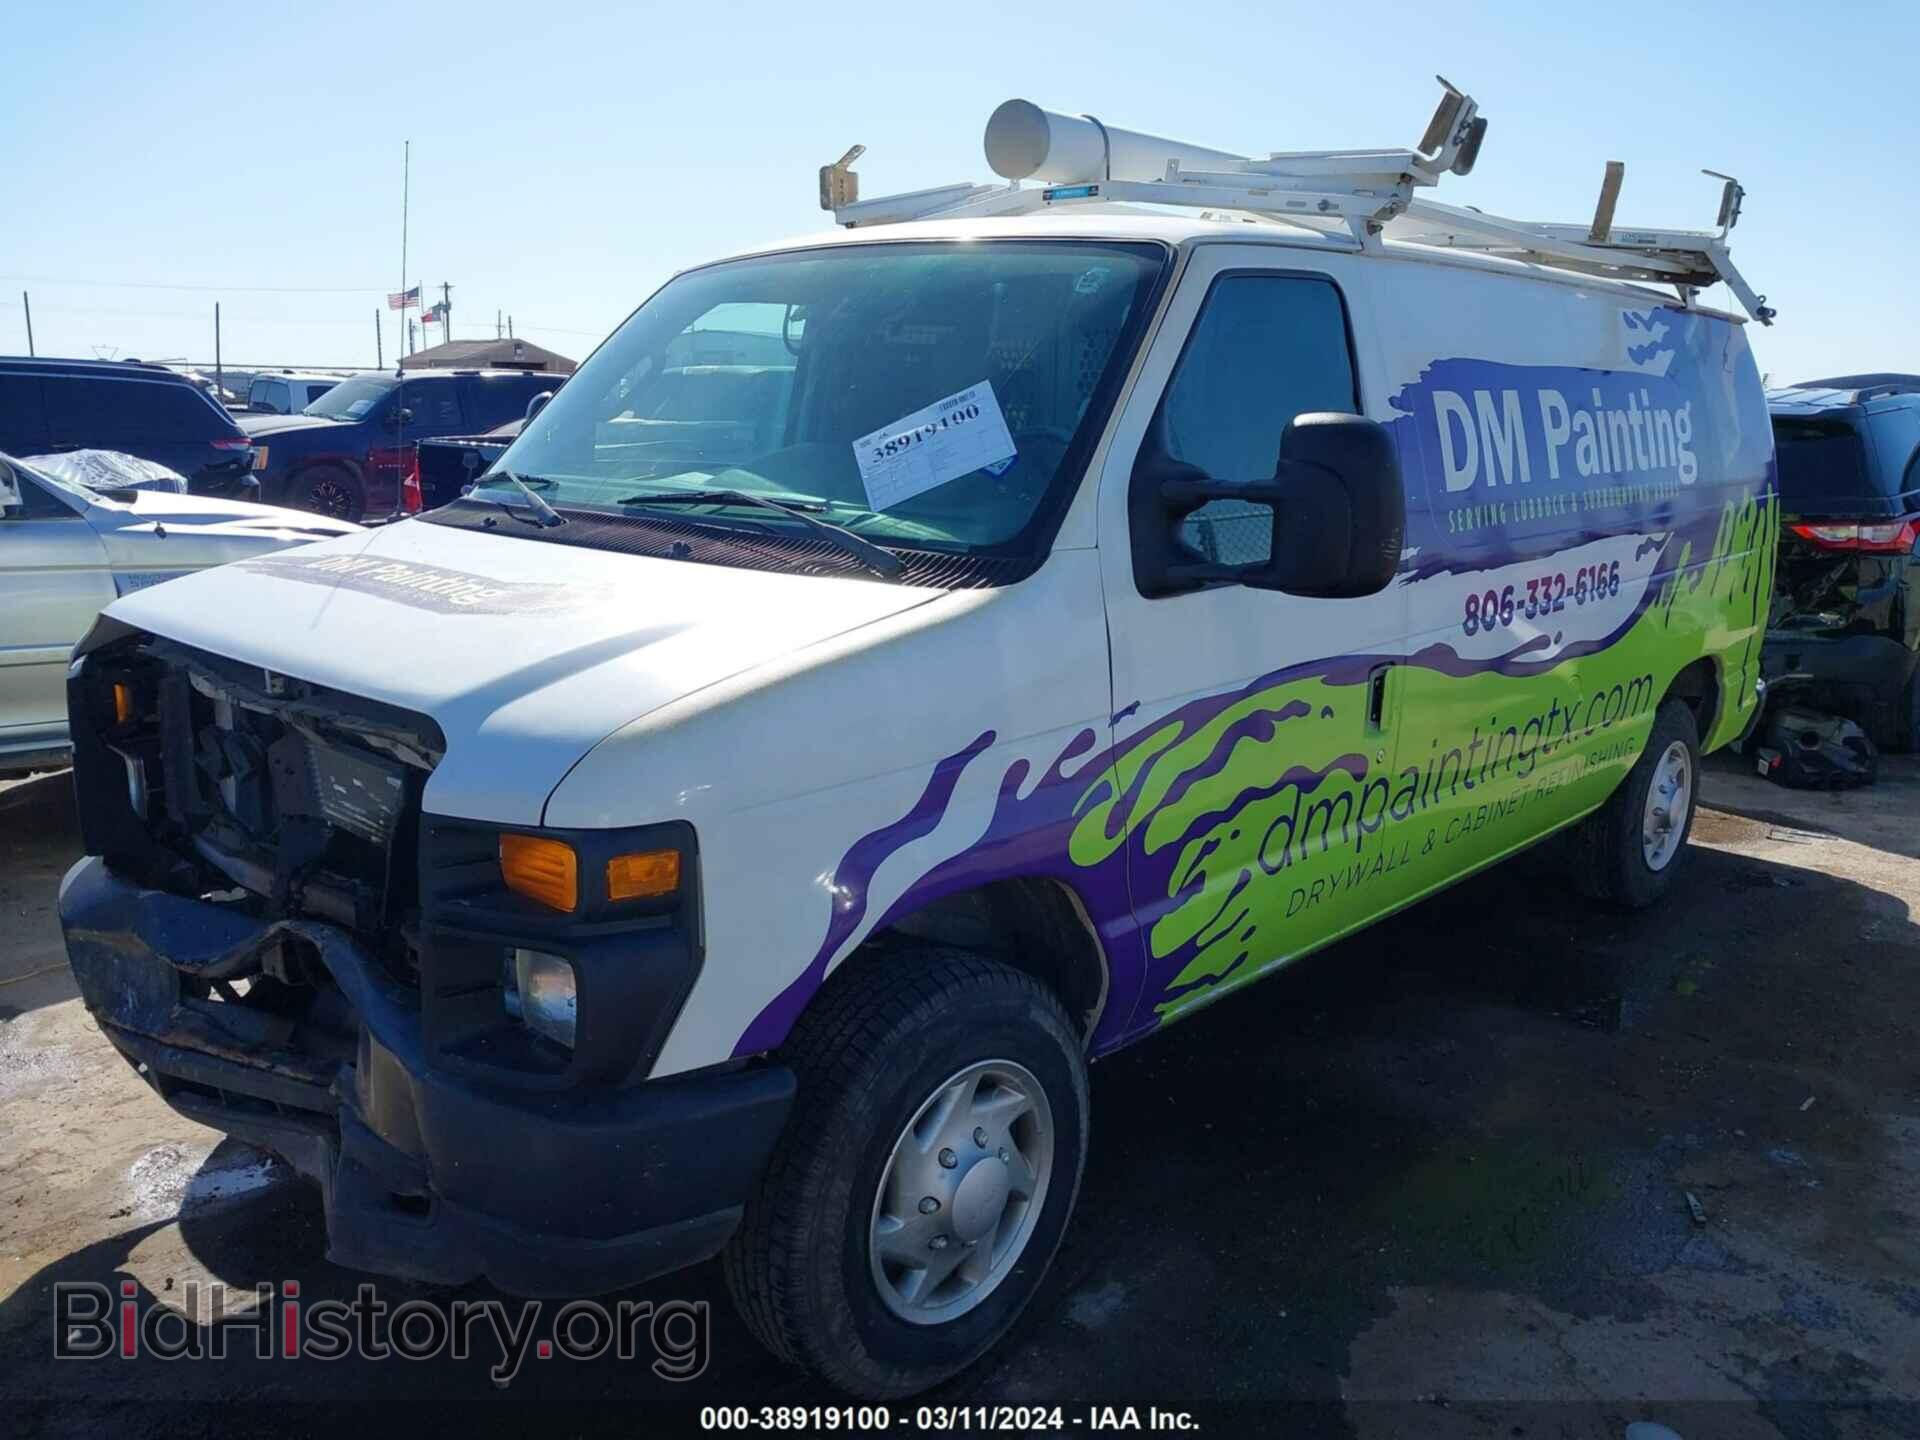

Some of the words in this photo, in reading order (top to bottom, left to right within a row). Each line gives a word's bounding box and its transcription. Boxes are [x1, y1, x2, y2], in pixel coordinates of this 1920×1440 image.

[873, 404, 979, 464] 38919100
[1432, 388, 1531, 492] DM
[1538, 387, 1698, 485] Painting
[1449, 502, 1507, 533] SERVING
[371, 563, 497, 605] Painting
[1463, 560, 1620, 637] 806-332-6166
[1258, 673, 1653, 876] dmpaintingtx.com
[1286, 841, 1411, 919] DRYWALL
[1421, 828, 1437, 855] &
[1445, 783, 1531, 845] CABINET
